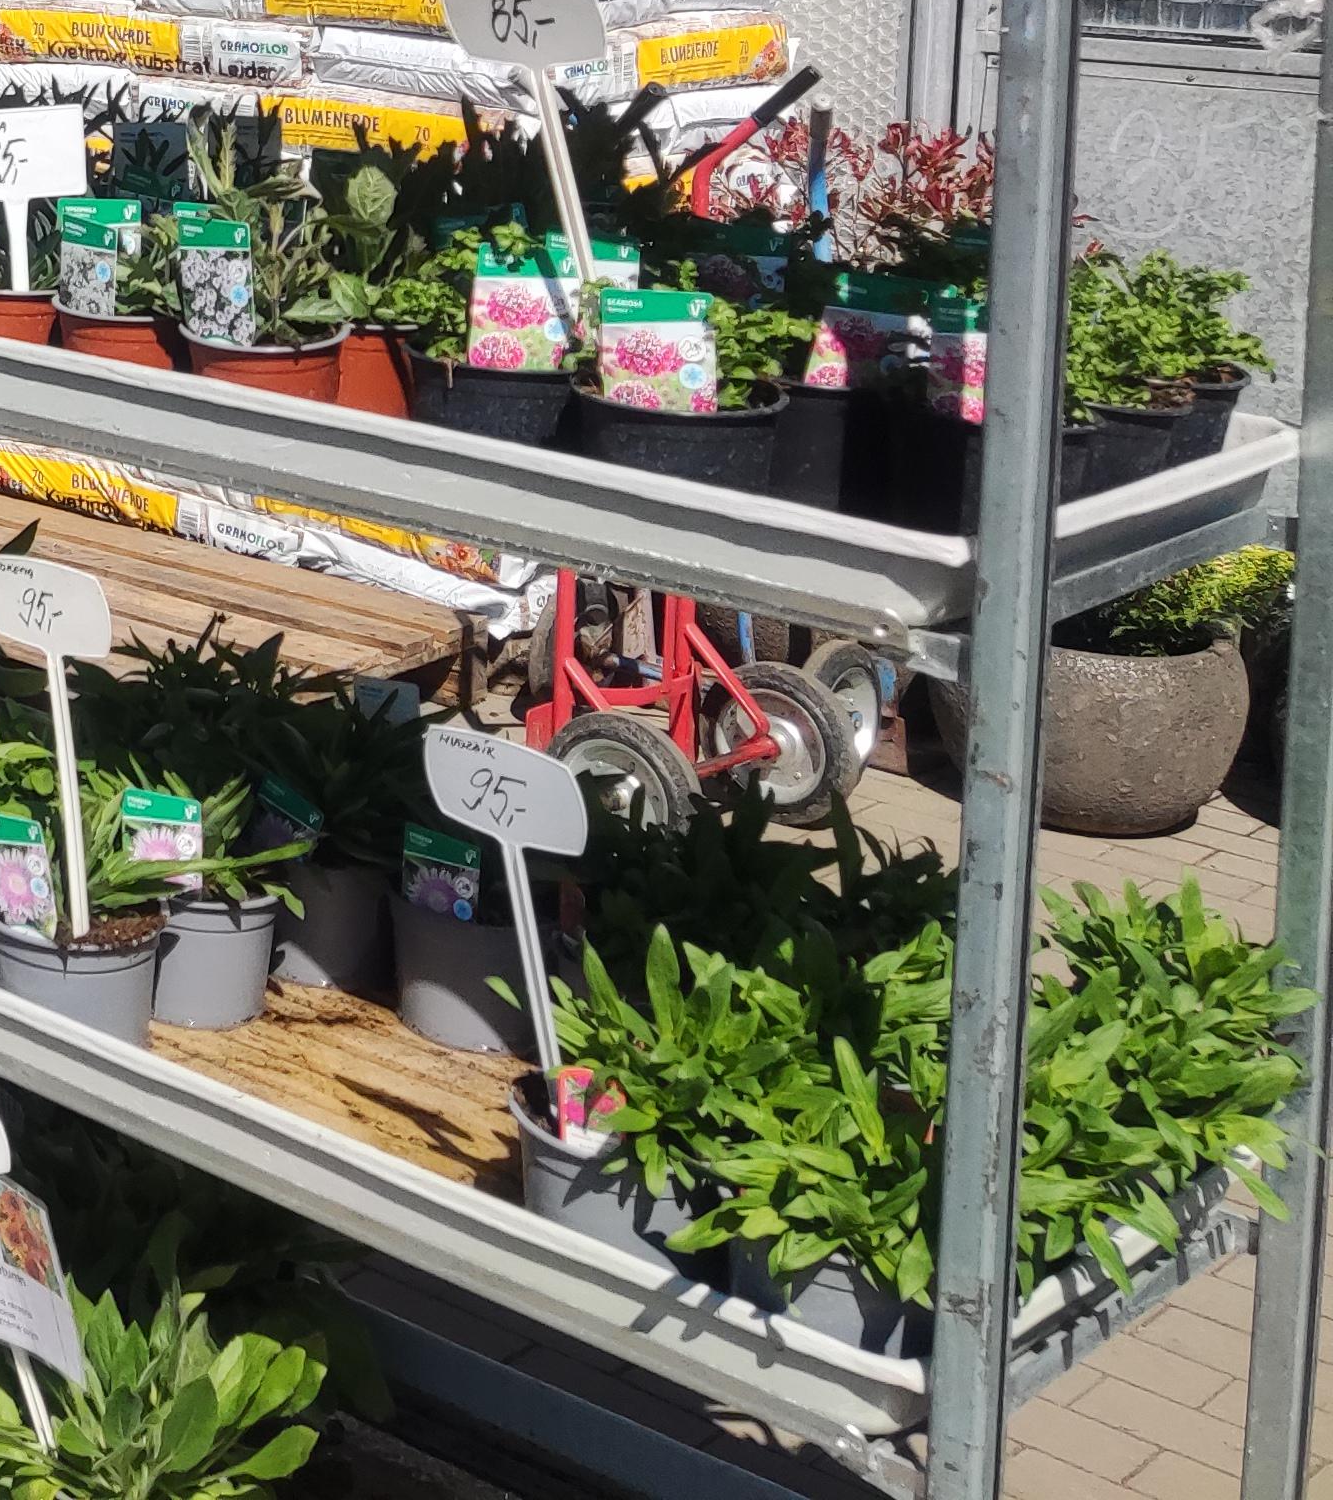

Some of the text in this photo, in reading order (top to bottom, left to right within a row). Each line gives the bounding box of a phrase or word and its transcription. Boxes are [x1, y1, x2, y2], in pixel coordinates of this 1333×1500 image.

[220, 39, 289, 56] GRAMOFLOR
[414, 125, 431, 142] 70
[18, 588, 63, 634] 95,-
[462, 767, 528, 829] 95,-
